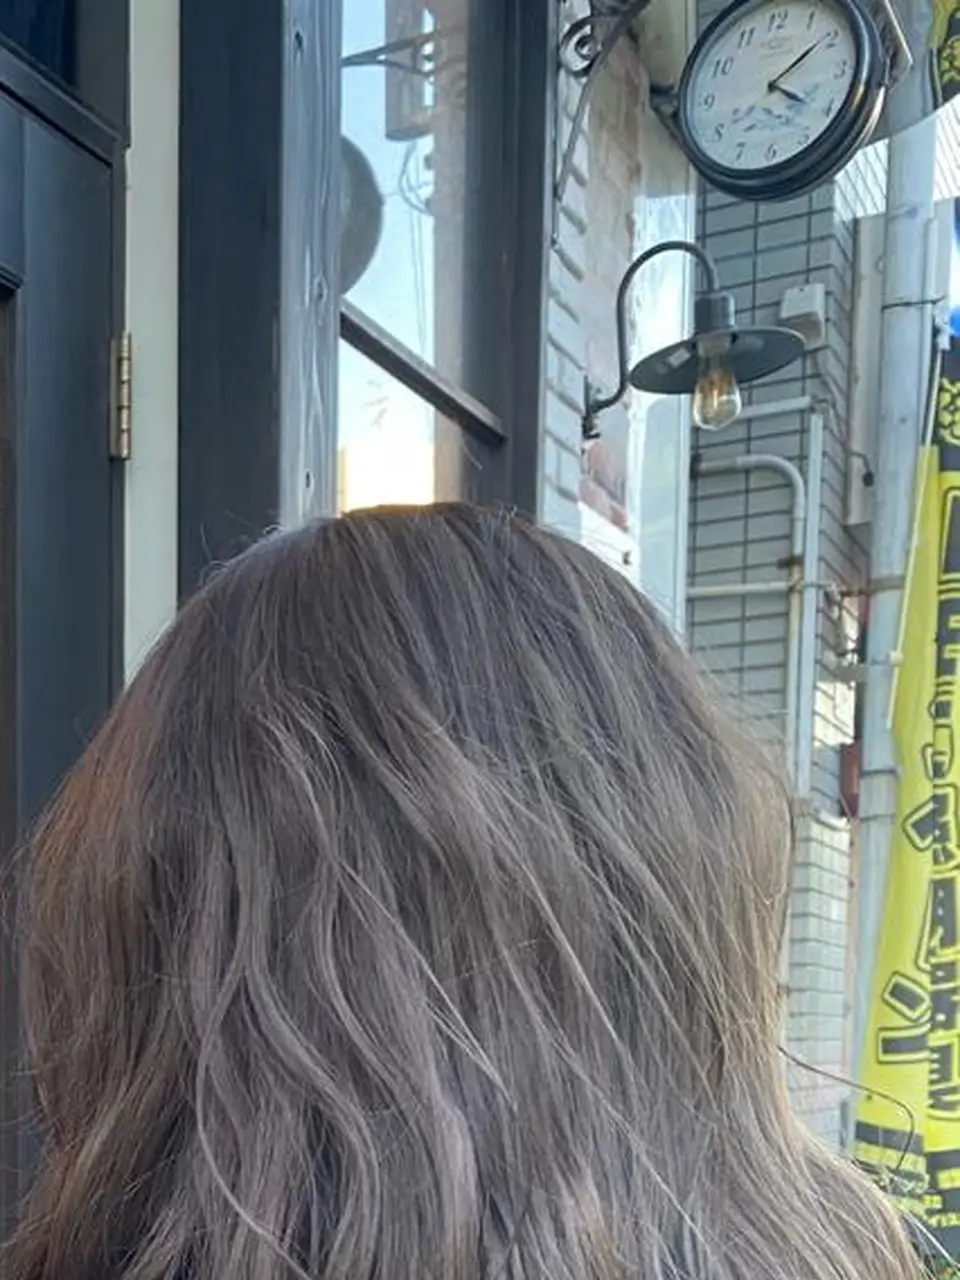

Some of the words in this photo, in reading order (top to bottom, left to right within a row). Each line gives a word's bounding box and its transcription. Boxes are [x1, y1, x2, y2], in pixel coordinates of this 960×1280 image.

[767, 10, 788, 32] 12
[806, 10, 816, 31] 1
[737, 27, 756, 50] 11
[710, 56, 735, 80] 10
[833, 59, 848, 80] 3
[703, 92, 715, 109] 9
[822, 97, 835, 118] 4
[713, 123, 725, 142] 8
[734, 142, 746, 161] 7
[763, 143, 778, 161] 6
